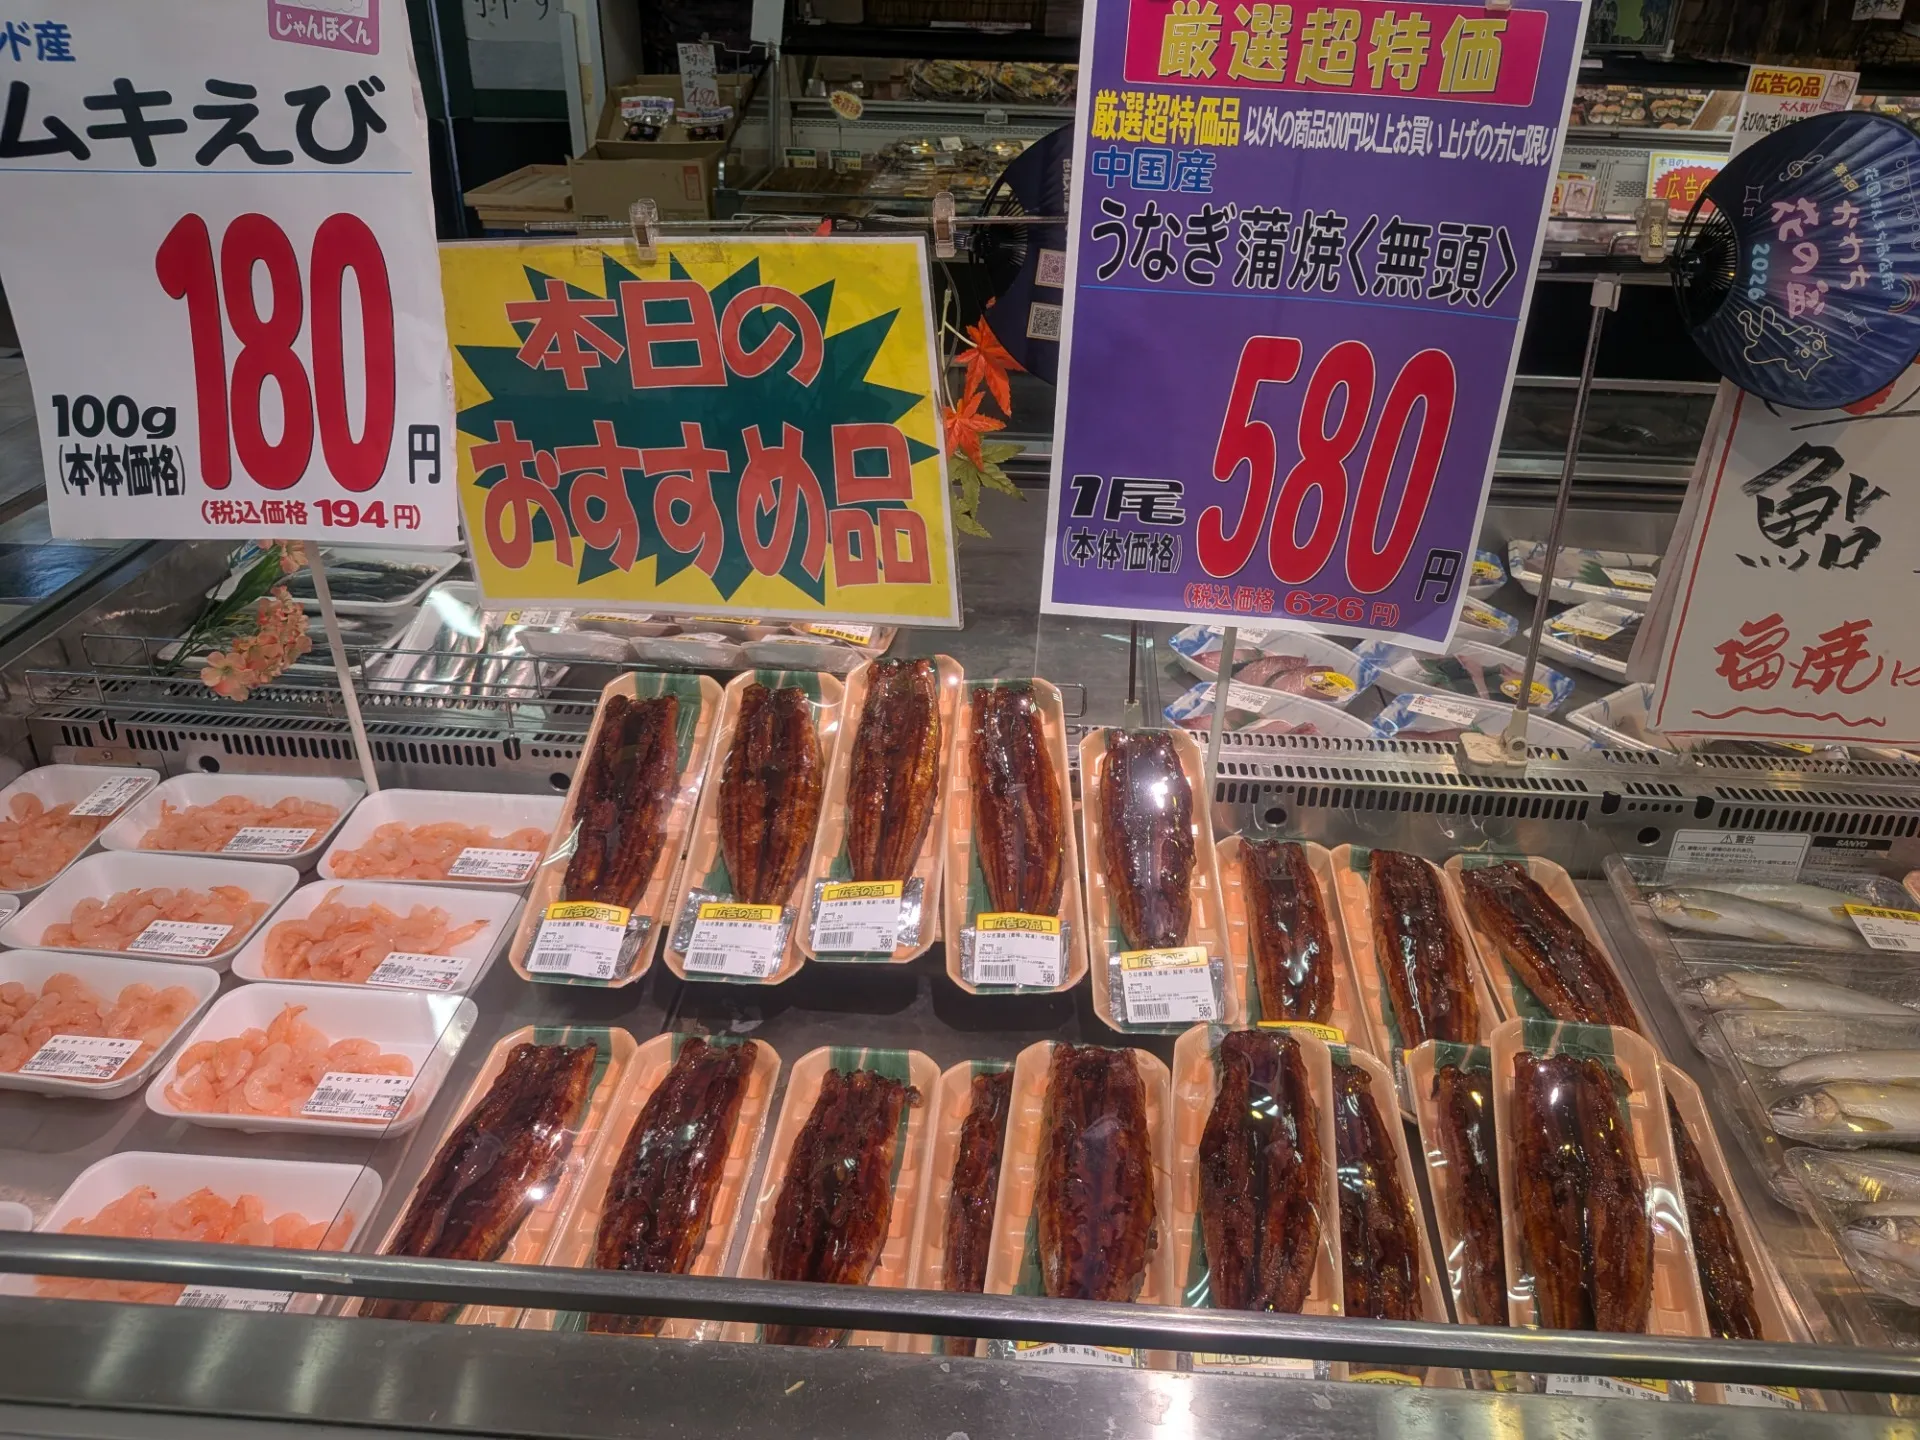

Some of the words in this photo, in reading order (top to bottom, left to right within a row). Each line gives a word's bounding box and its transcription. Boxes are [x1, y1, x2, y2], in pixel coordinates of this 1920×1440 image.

[0, 20, 76, 62] ド産
[1157, 0, 1508, 95] 厳選超特価
[1751, 72, 1820, 97] 広告の品
[0, 76, 387, 167] ムキえび
[1091, 89, 1240, 146] 厳選超特価品
[1091, 146, 1217, 193] 中国産
[1832, 200, 1871, 290] かわち
[1748, 243, 1771, 301] 2026
[155, 213, 396, 492] 180
[408, 424, 440, 485] 円
[505, 279, 825, 389] 本日の
[52, 395, 177, 438] 100g
[1196, 335, 1456, 595] 580
[1415, 548, 1464, 604] 円
[470, 420, 931, 588] おすすめ品
[1070, 476, 1186, 526] 1尾
[1736, 441, 1890, 571] 鮎
[1836, 840, 1868, 848] SANYO
[880, 938, 892, 948] 580
[596, 964, 611, 975] 580
[752, 963, 765, 975] 580
[1043, 973, 1055, 983] 580
[1198, 1006, 1212, 1017] 580
